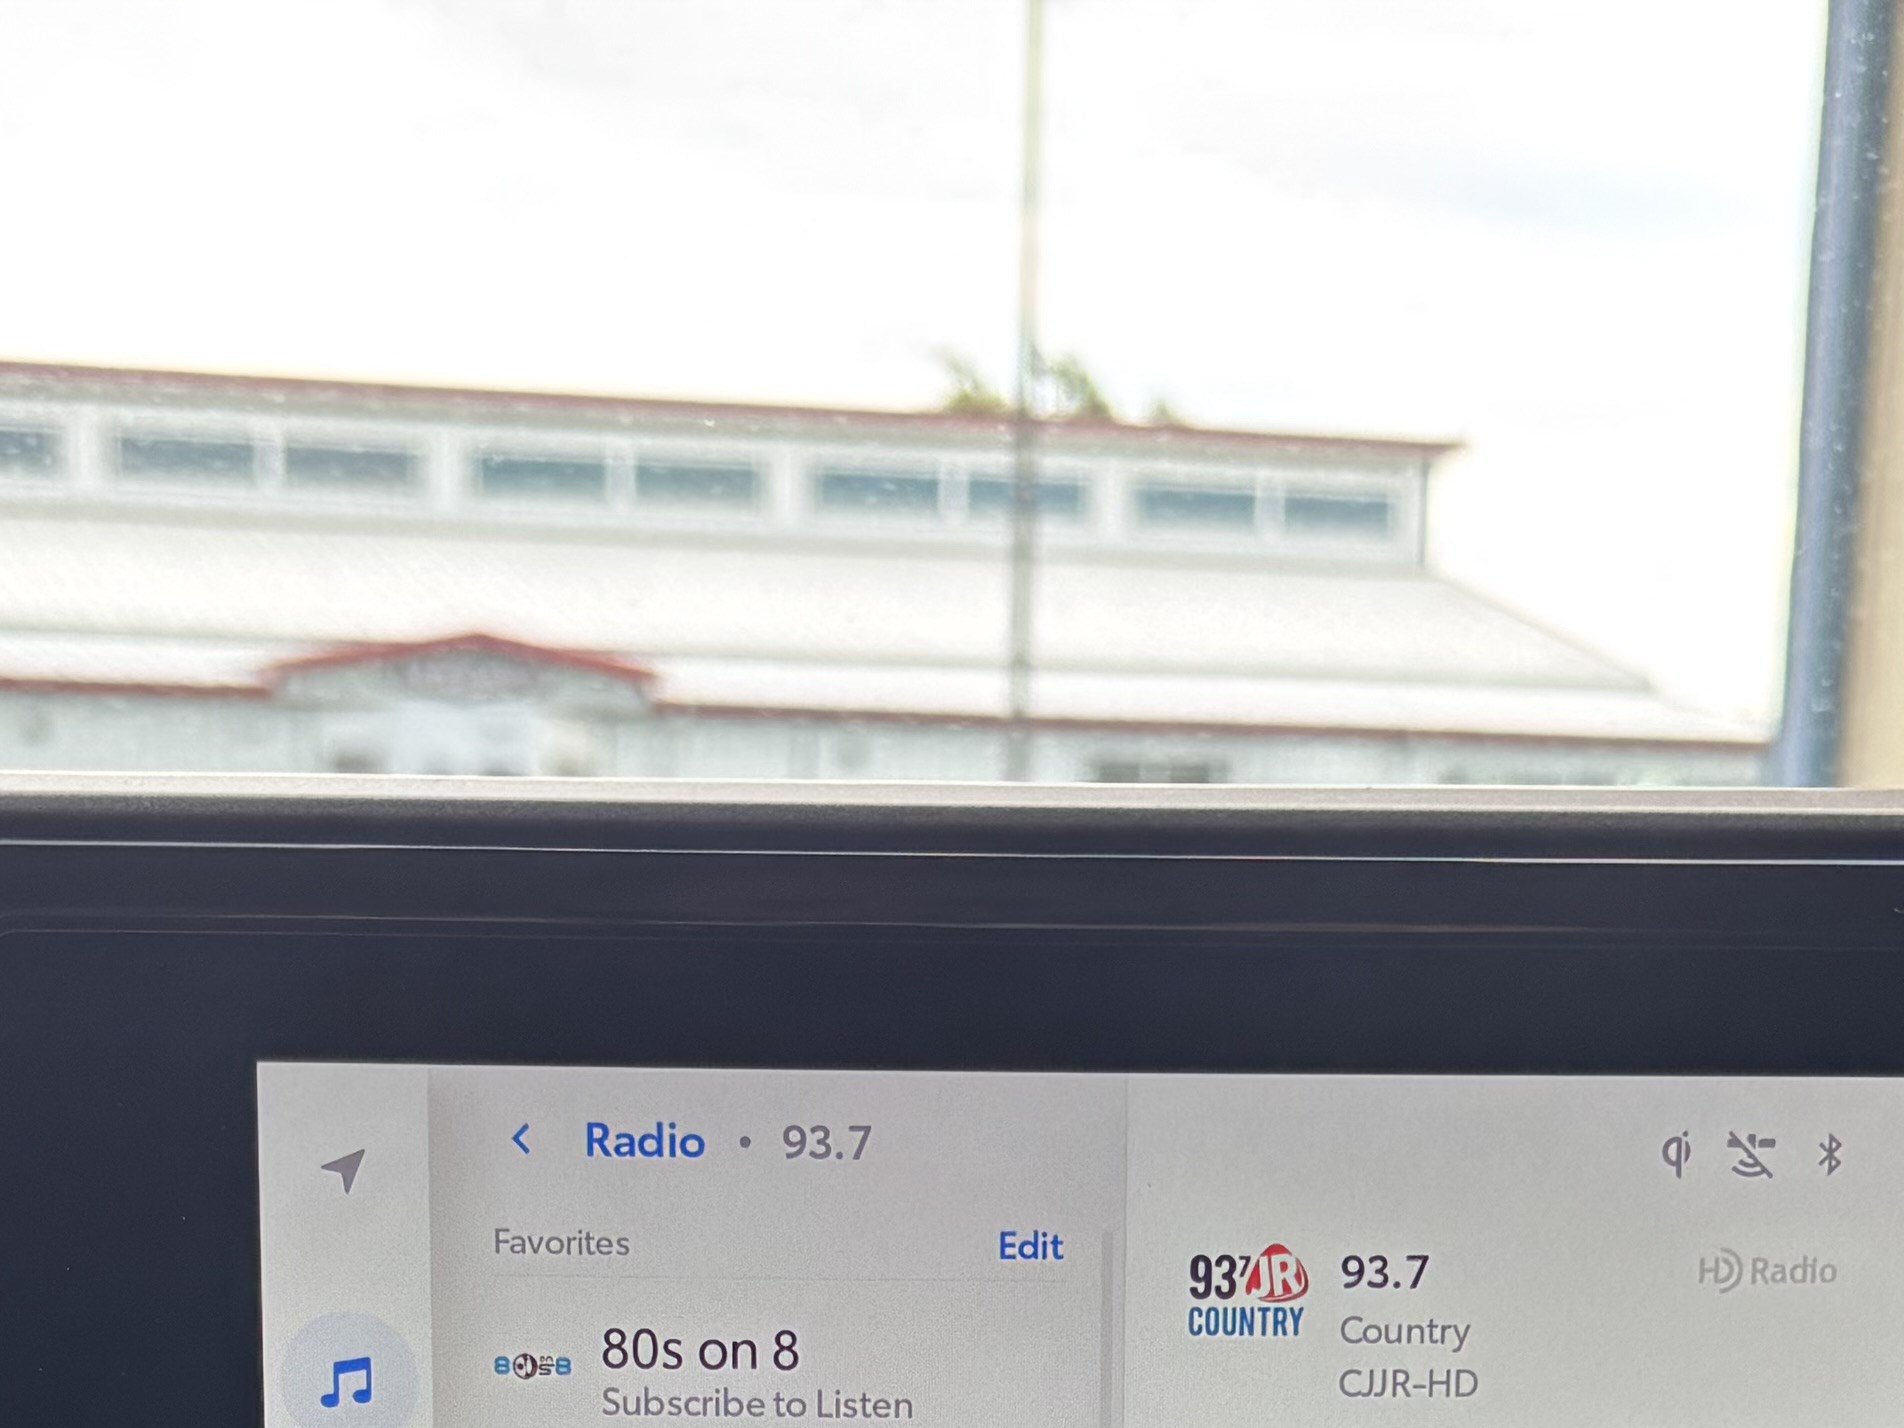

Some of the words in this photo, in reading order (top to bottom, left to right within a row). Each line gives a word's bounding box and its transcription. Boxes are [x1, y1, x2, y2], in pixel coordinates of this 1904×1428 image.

[585, 1121, 707, 1161] Radio
[781, 1124, 873, 1162] 93.7
[494, 1227, 631, 1258] Favorites
[998, 1229, 1065, 1262] Edit
[1340, 1253, 1430, 1291] 93.7
[1750, 1254, 1838, 1285] Radio
[1188, 1306, 1304, 1337] COUNTRY
[1340, 1316, 1471, 1353] Country
[602, 1327, 684, 1372] 80s
[697, 1337, 759, 1371] on
[773, 1329, 800, 1371] 8
[1339, 1367, 1479, 1399] CJJR-HD
[602, 1387, 767, 1420] Subscribe
[774, 1390, 808, 1420] to
[816, 1388, 914, 1420] Listen
